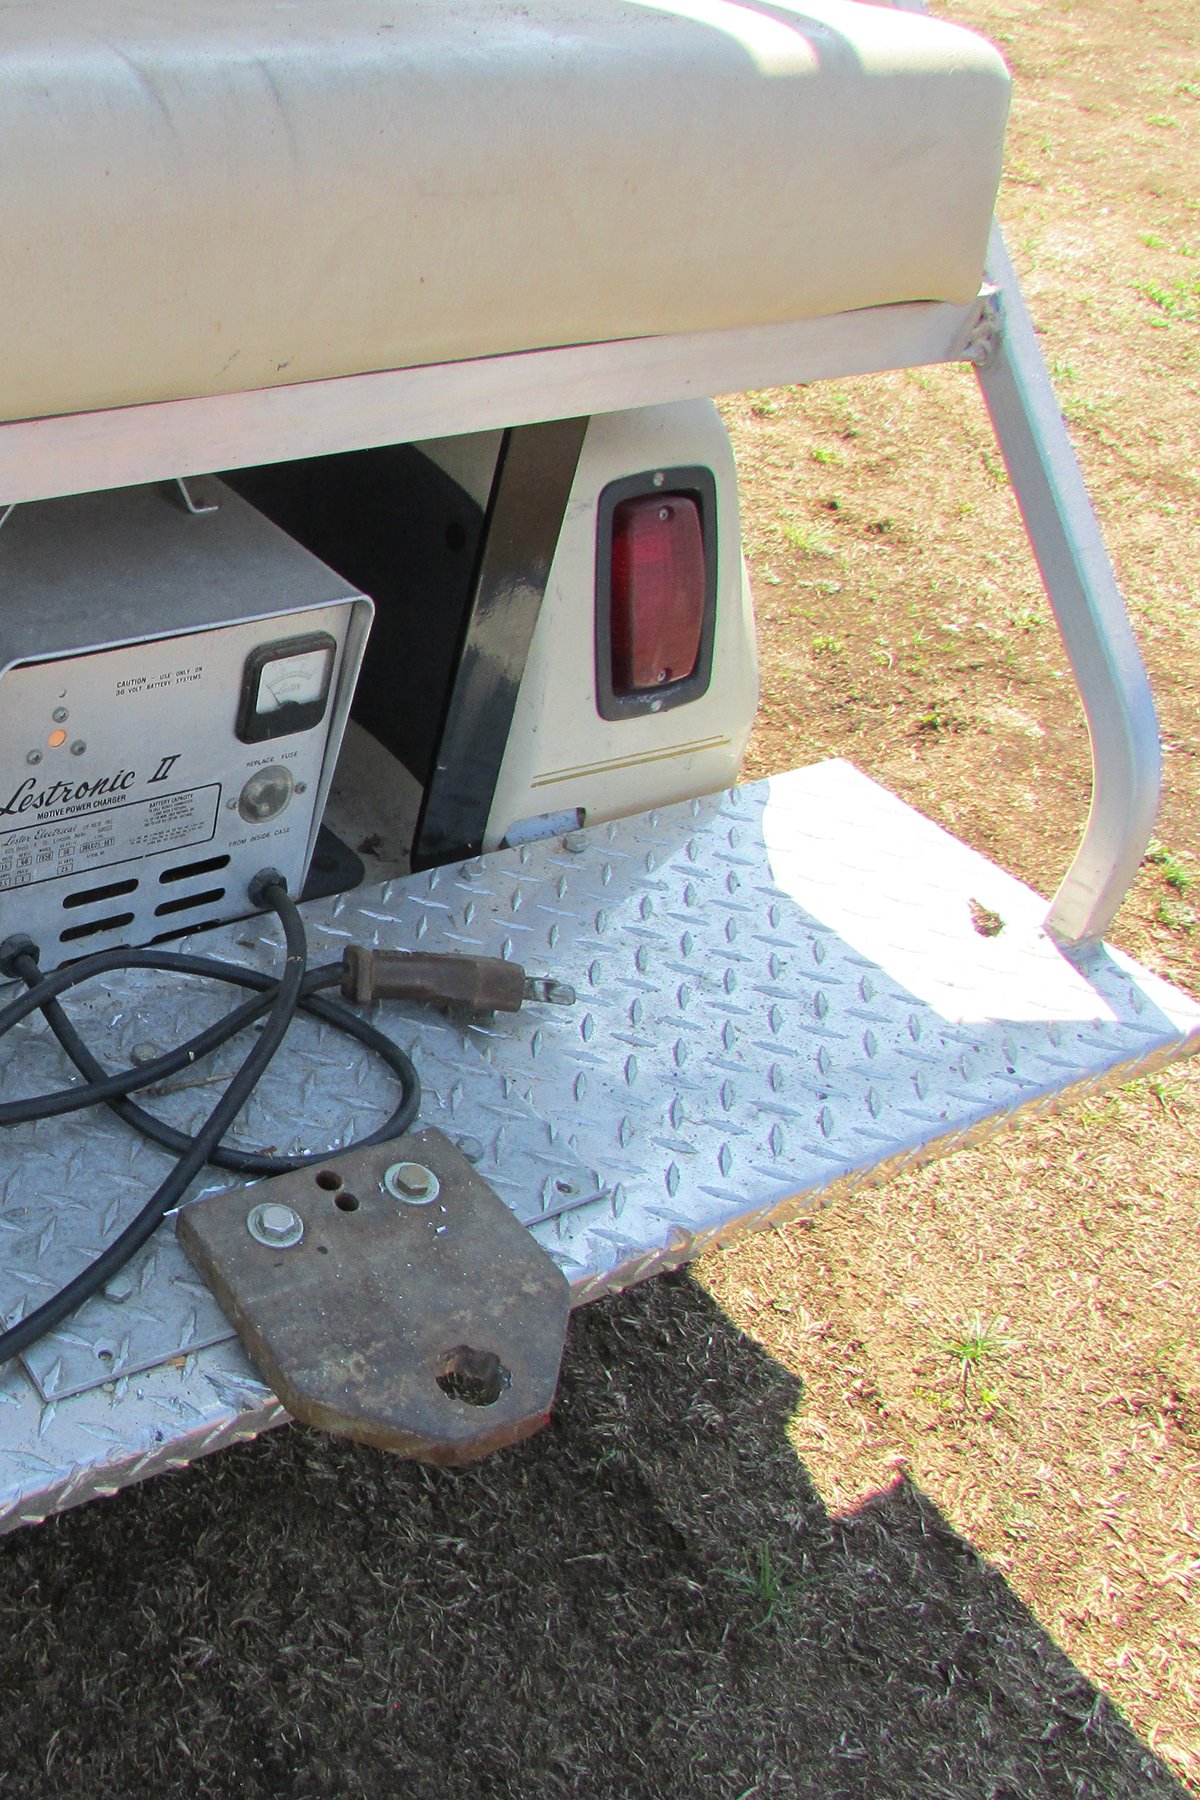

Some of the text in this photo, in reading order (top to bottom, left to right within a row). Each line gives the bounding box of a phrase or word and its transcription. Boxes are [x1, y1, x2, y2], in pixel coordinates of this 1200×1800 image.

[116, 673, 201, 697] 36 VOLT BATTERY SYSTEMS
[117, 677, 147, 689] CAUTION
[176, 668, 191, 677] ONLY
[147, 754, 181, 784] II
[246, 751, 298, 768] REPLACE FUSE
[36, 794, 127, 821] MOTIVE POWER CHARGER
[171, 793, 194, 803] CAPACITY
[228, 827, 290, 847] FROM INSIDE CASE
